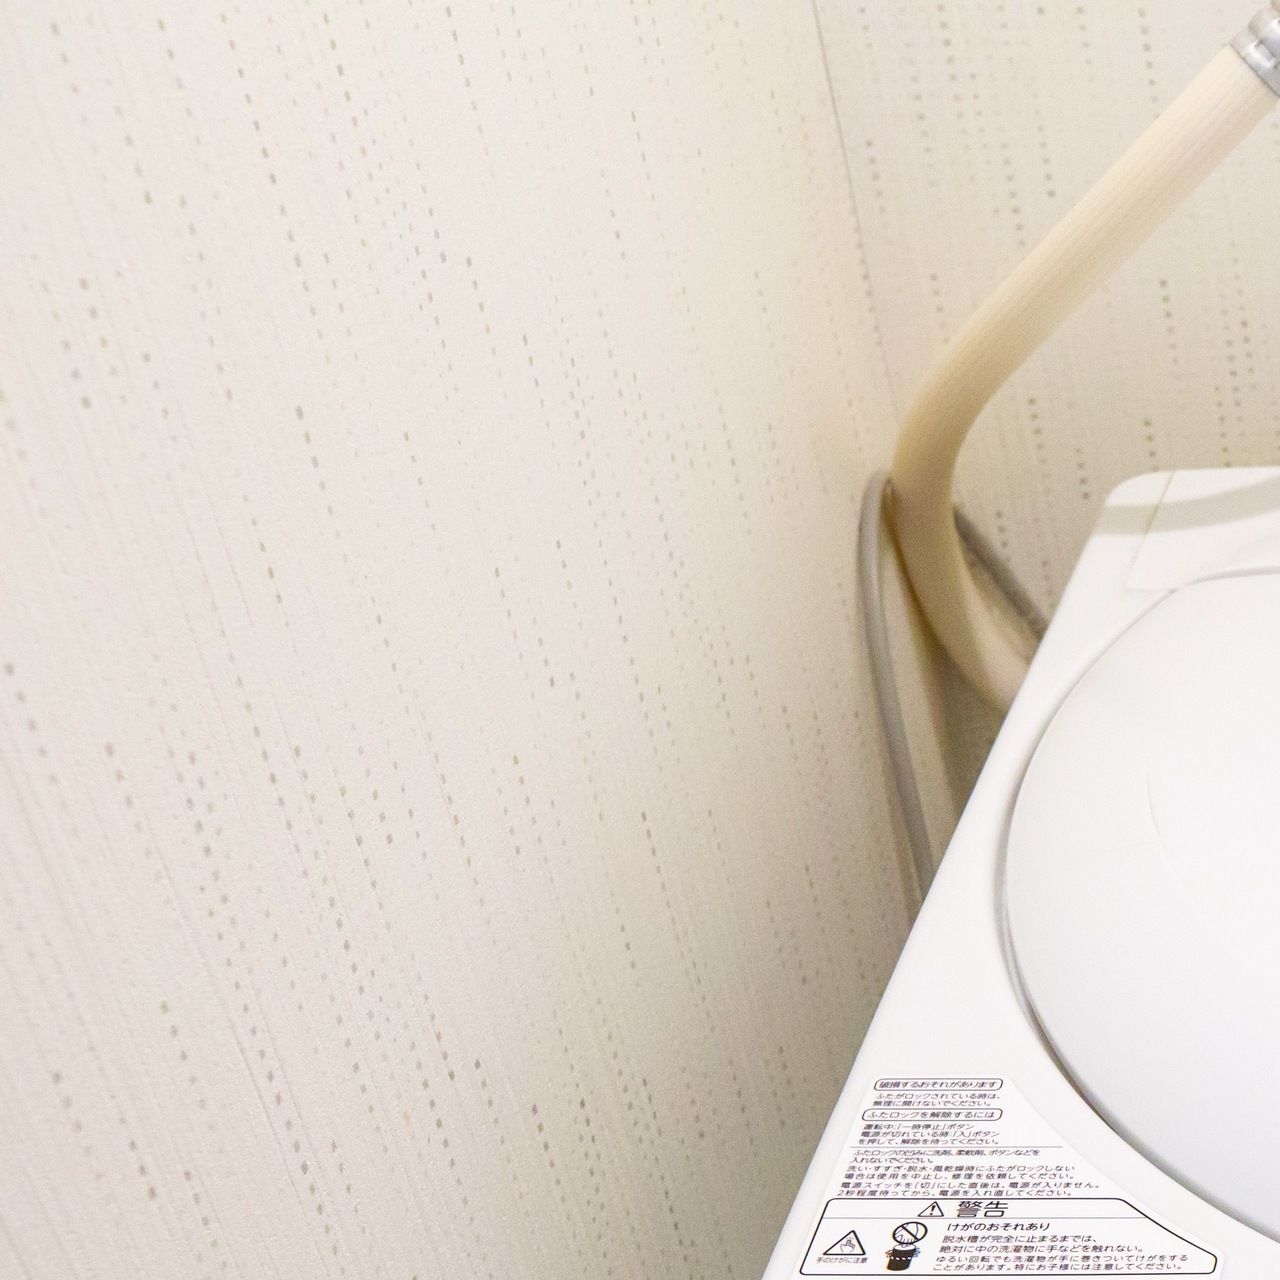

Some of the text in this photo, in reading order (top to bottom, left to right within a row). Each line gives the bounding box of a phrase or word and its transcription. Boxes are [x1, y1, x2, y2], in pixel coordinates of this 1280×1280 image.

[957, 1201, 1009, 1218] 警告
[946, 1222, 1051, 1232] けがのおそれあり
